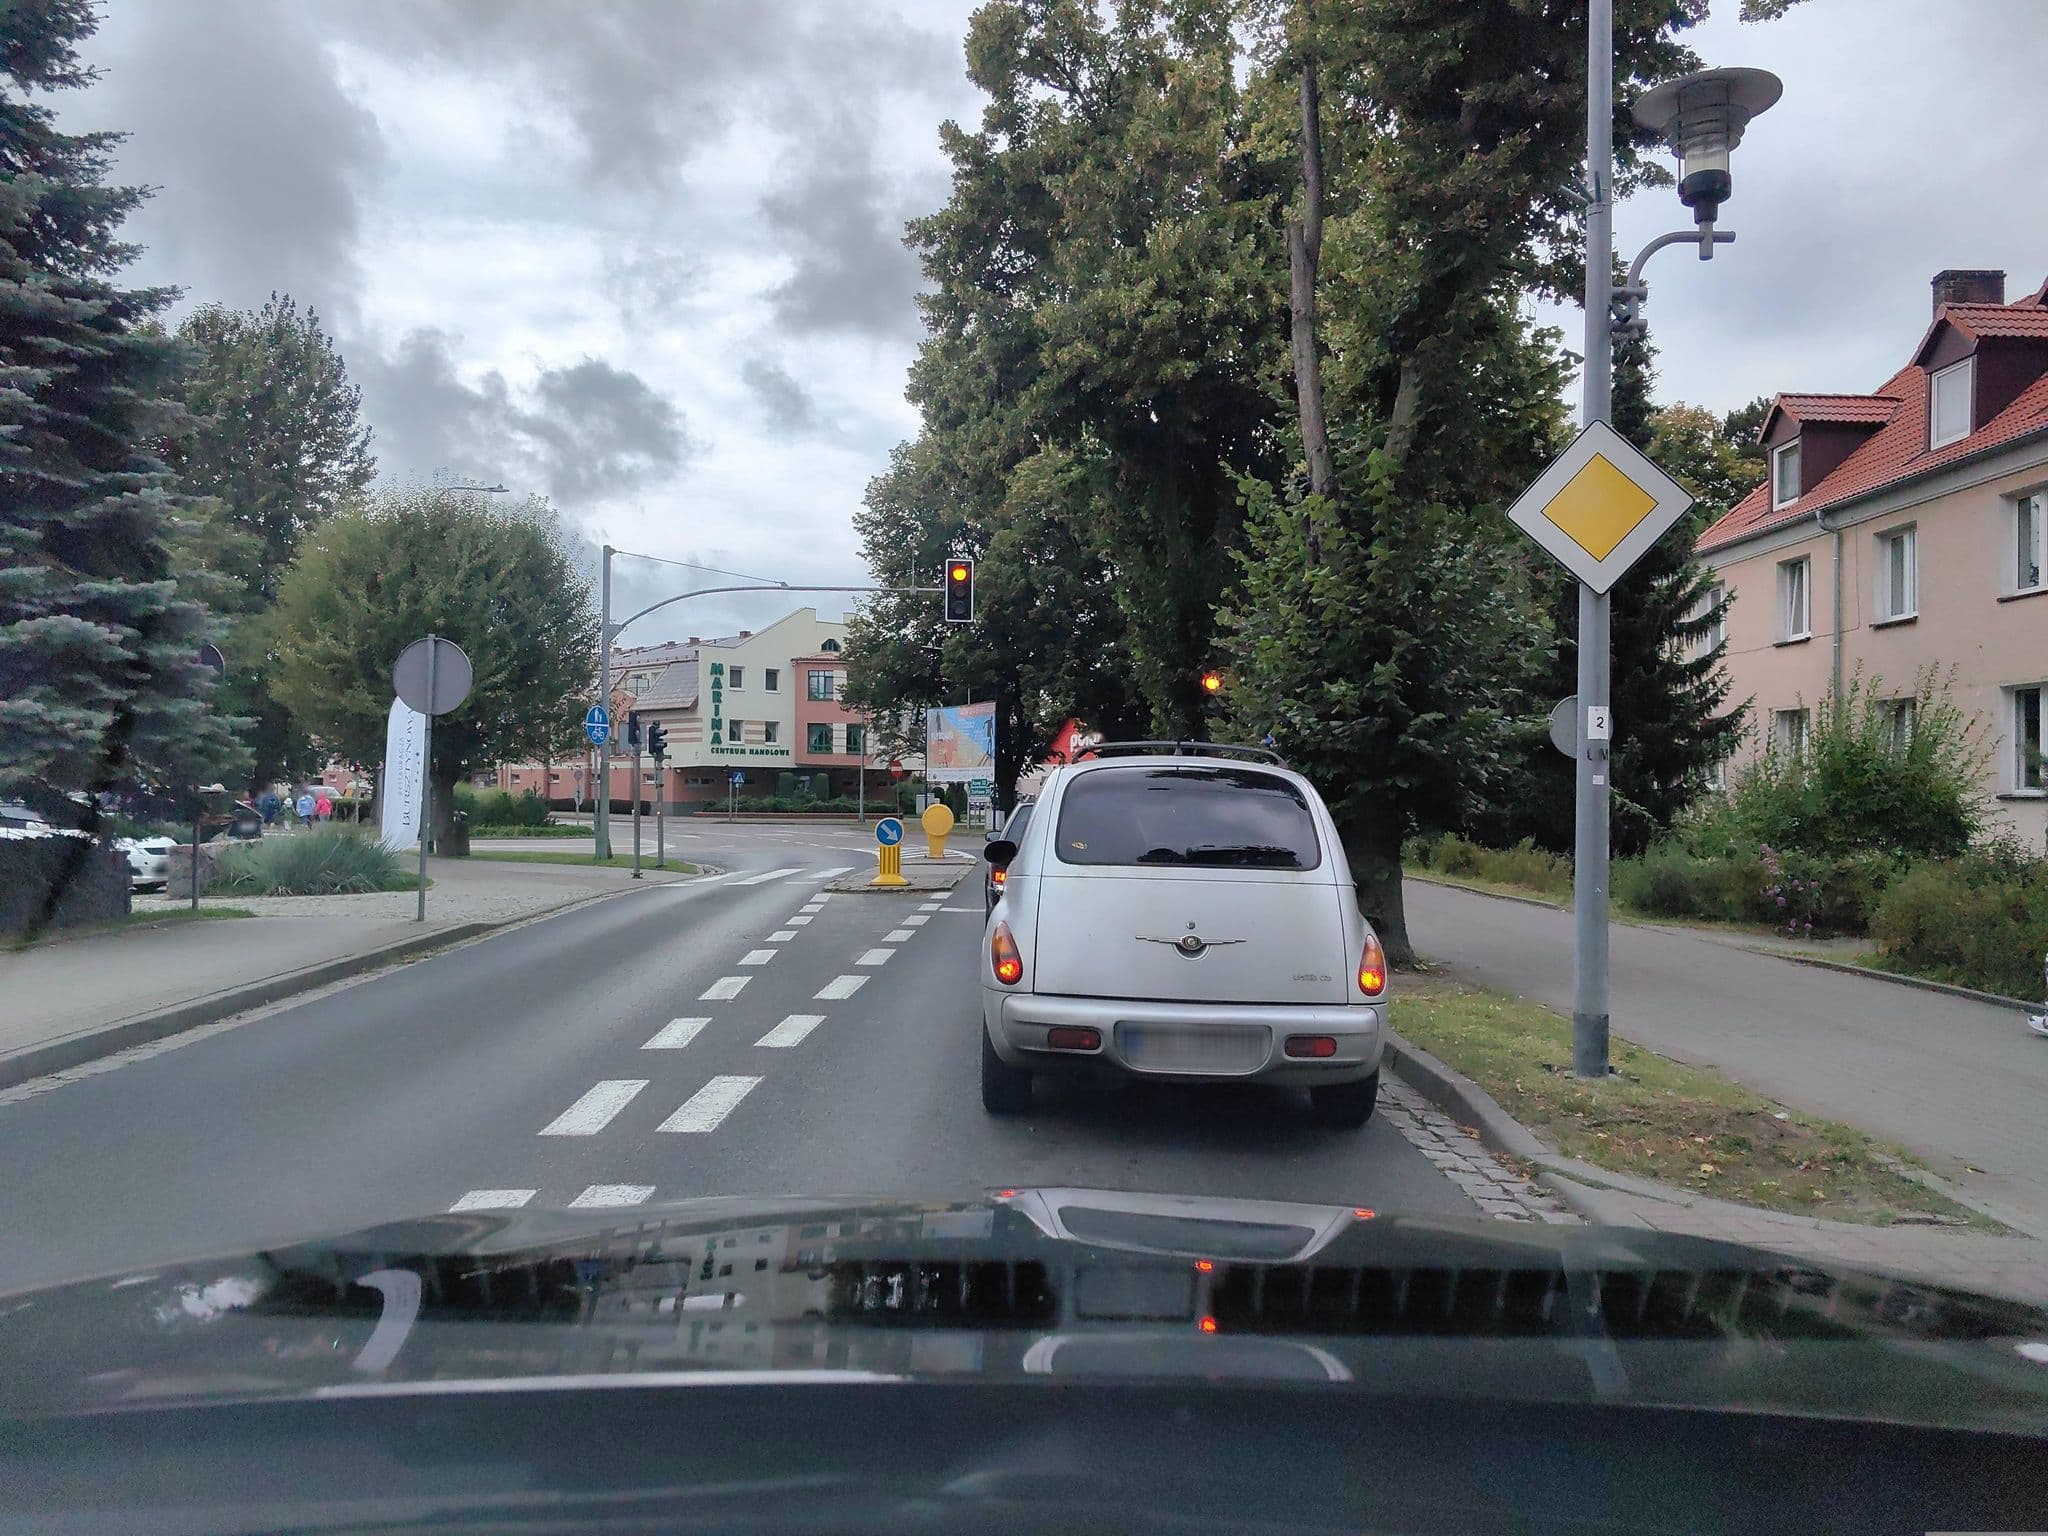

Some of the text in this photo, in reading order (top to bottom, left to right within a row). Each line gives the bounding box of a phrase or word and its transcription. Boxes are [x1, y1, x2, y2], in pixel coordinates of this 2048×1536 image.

[710, 662, 724, 745] MARINA
[1596, 716, 1605, 729] 2
[711, 747, 790, 756] CENTRUM HANDLOWE
